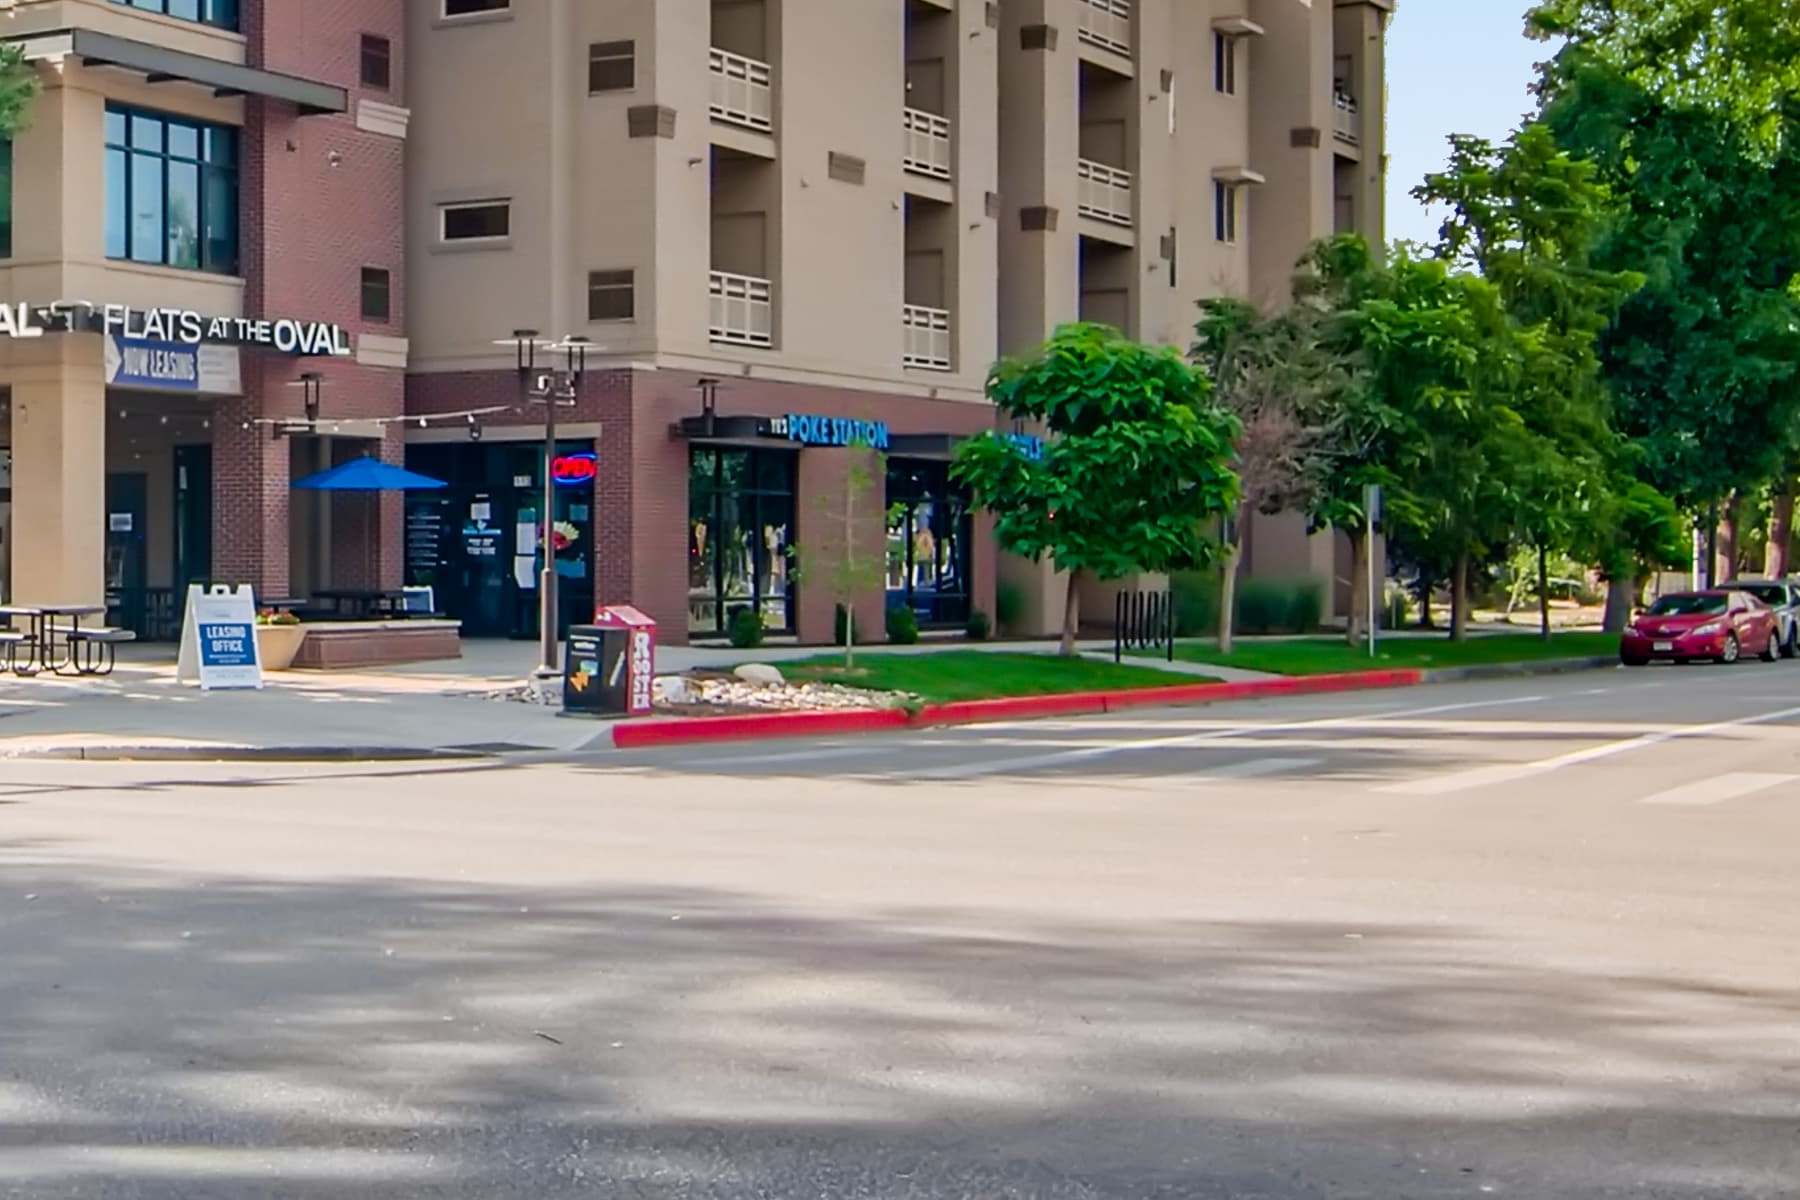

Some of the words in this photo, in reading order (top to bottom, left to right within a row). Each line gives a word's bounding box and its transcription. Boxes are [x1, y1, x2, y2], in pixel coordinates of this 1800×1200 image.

[103, 303, 202, 344] FLATS
[207, 317, 230, 339] AT
[234, 318, 271, 342] THE
[273, 319, 351, 356] OVAL
[788, 413, 830, 444] POKE
[831, 417, 889, 449] STATION
[551, 456, 597, 478] OPEN
[206, 625, 246, 639] LEASING
[212, 639, 244, 652] OFFICE
